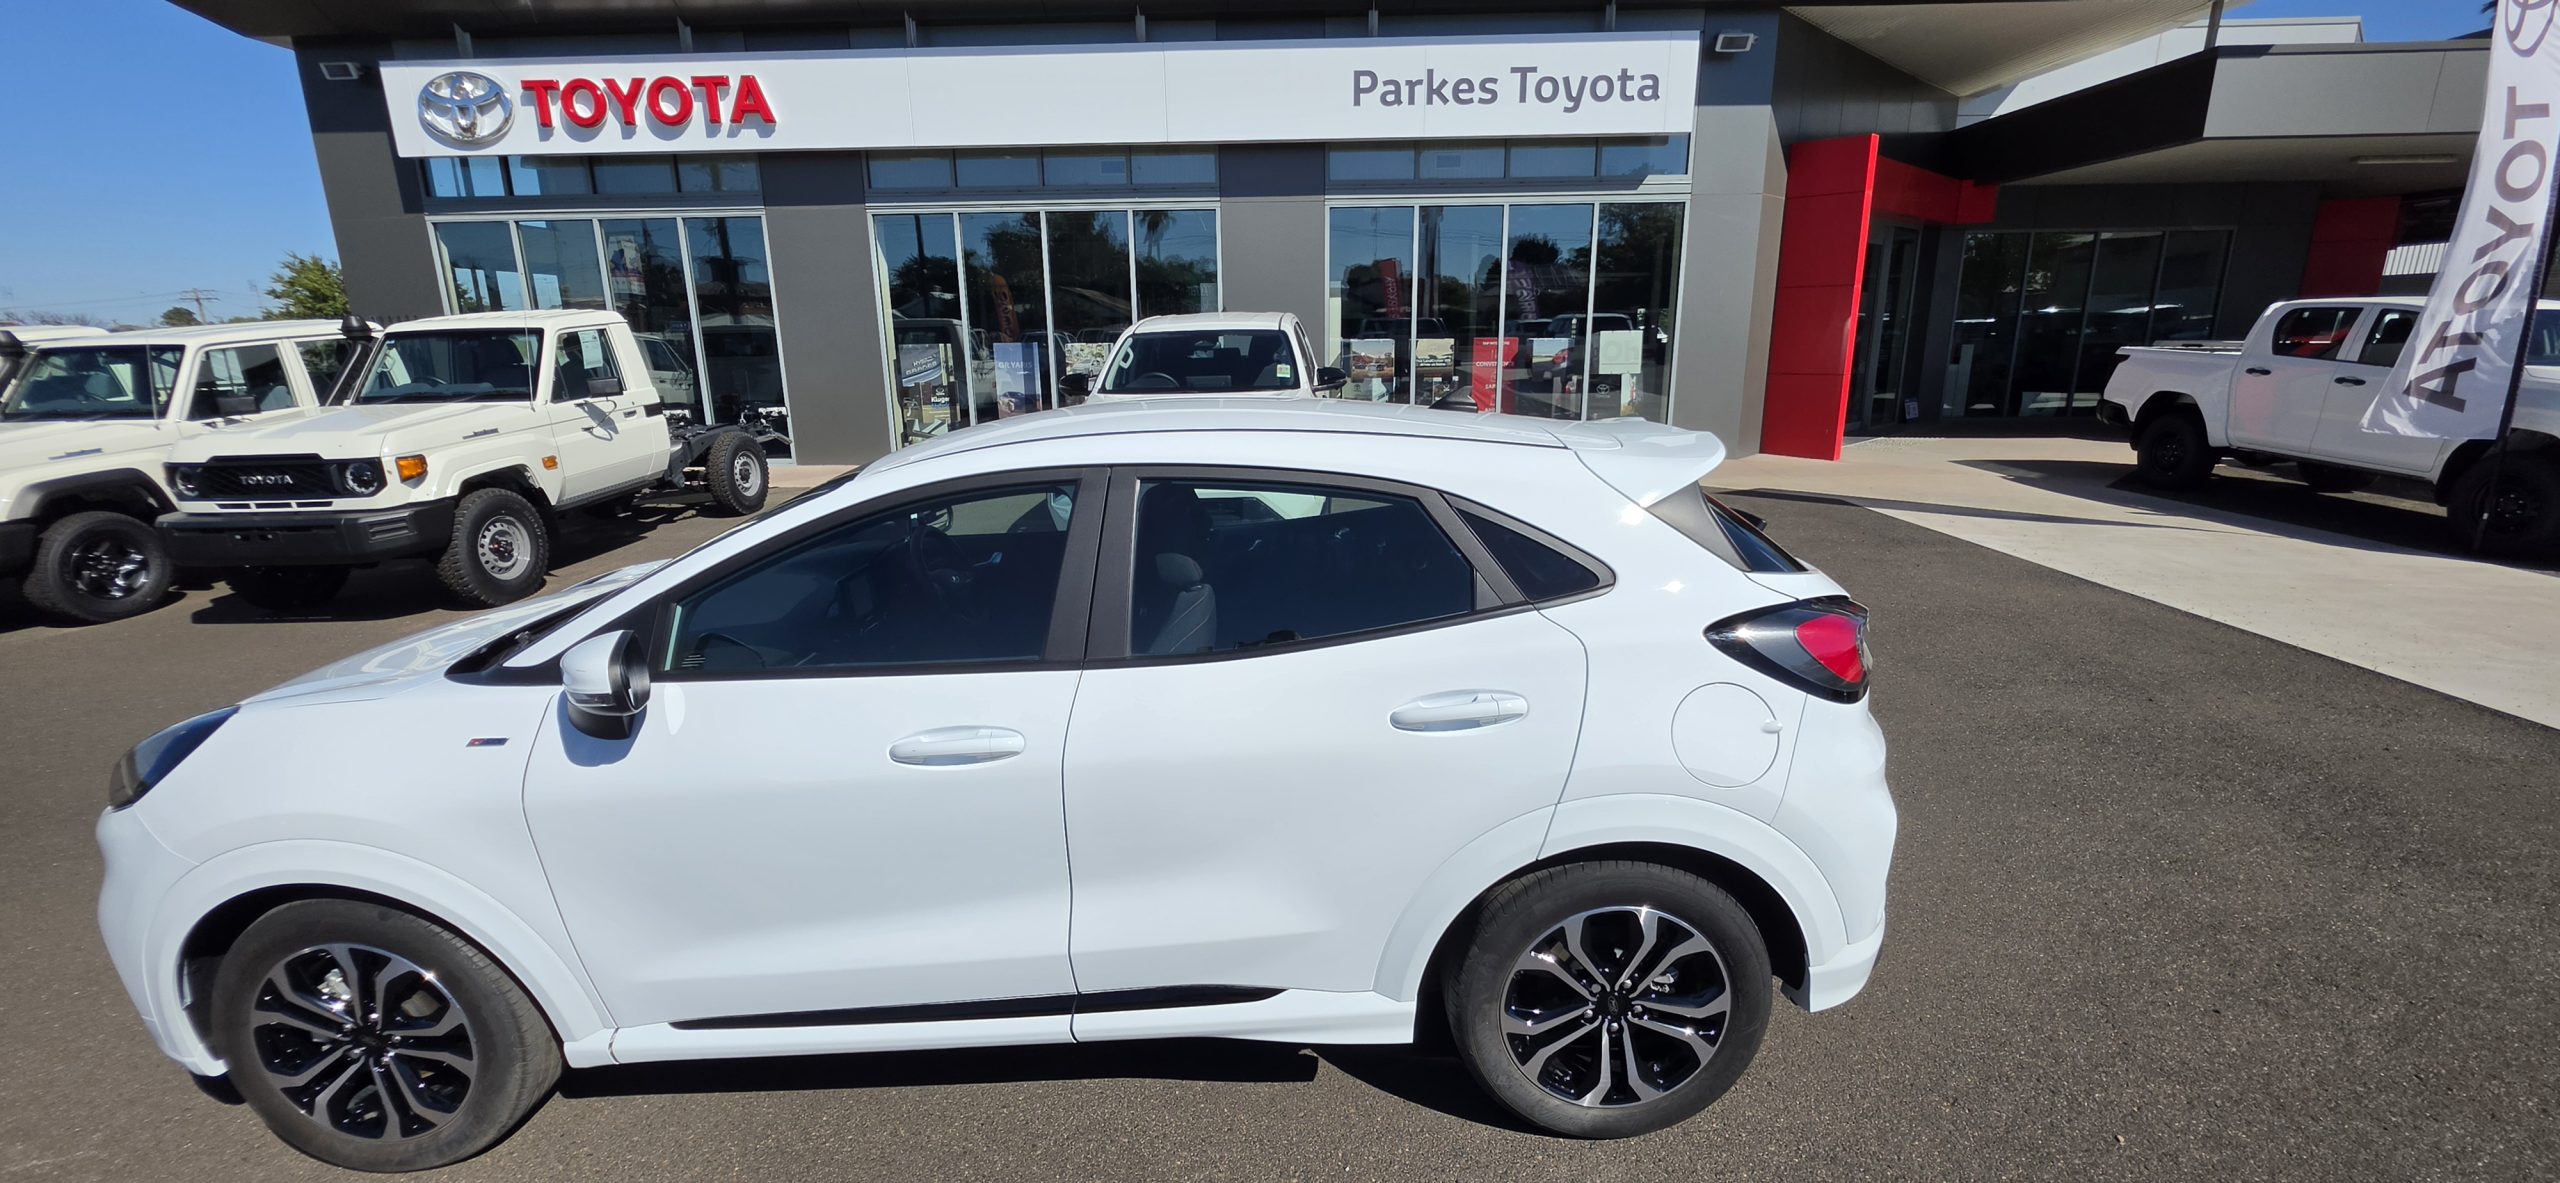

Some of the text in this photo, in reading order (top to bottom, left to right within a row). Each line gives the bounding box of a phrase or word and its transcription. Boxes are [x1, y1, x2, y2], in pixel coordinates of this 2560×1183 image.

[520, 74, 777, 128] TOYOTA
[1353, 66, 1661, 113] Parkes Toyota
[239, 474, 293, 485] TOYOTA
